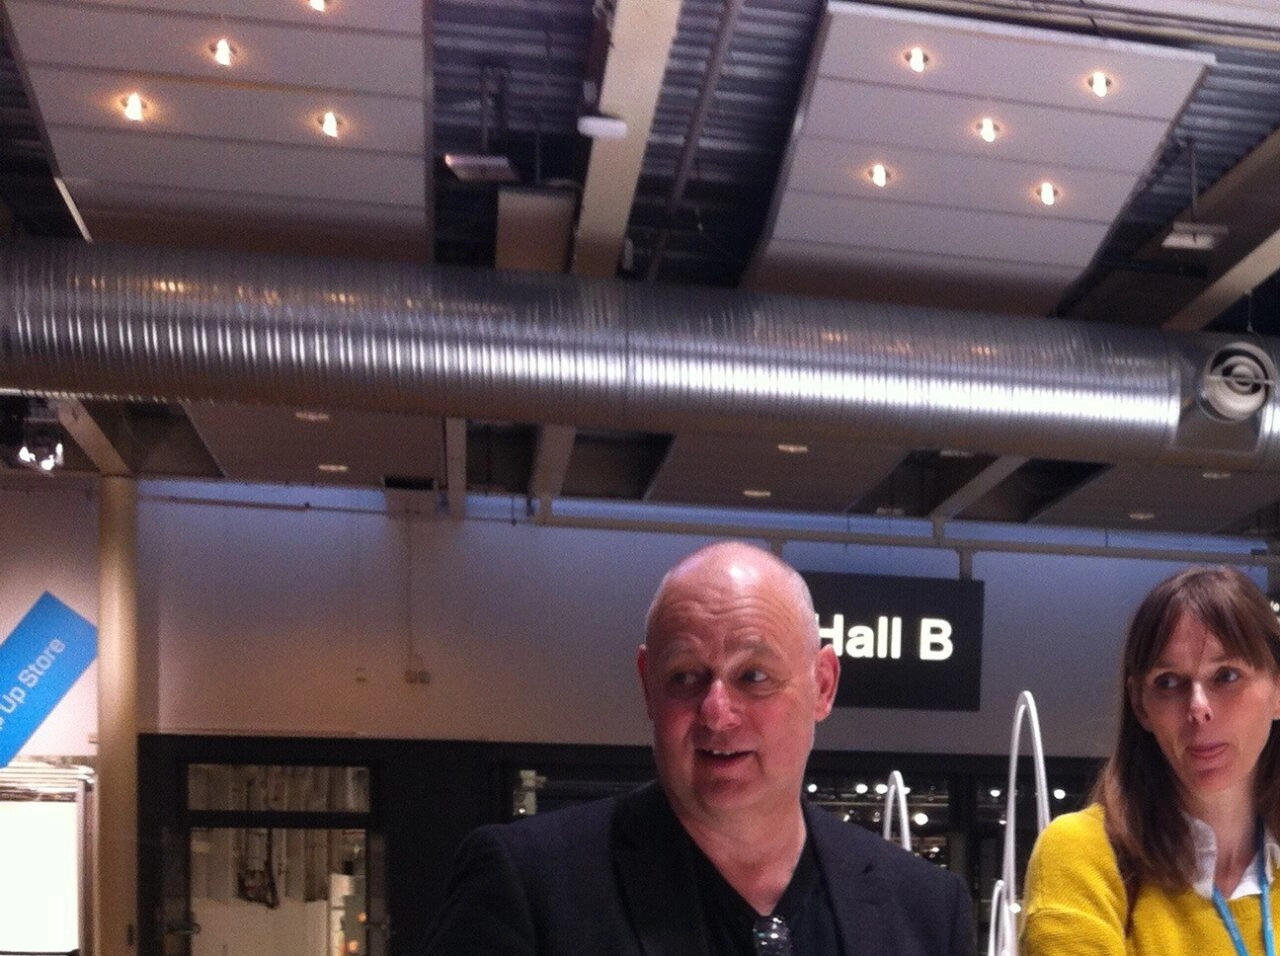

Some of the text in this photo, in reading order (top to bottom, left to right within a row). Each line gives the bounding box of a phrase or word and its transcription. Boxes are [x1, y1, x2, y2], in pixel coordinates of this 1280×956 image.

[815, 613, 955, 662] Hall B
[18, 639, 66, 688] Store
